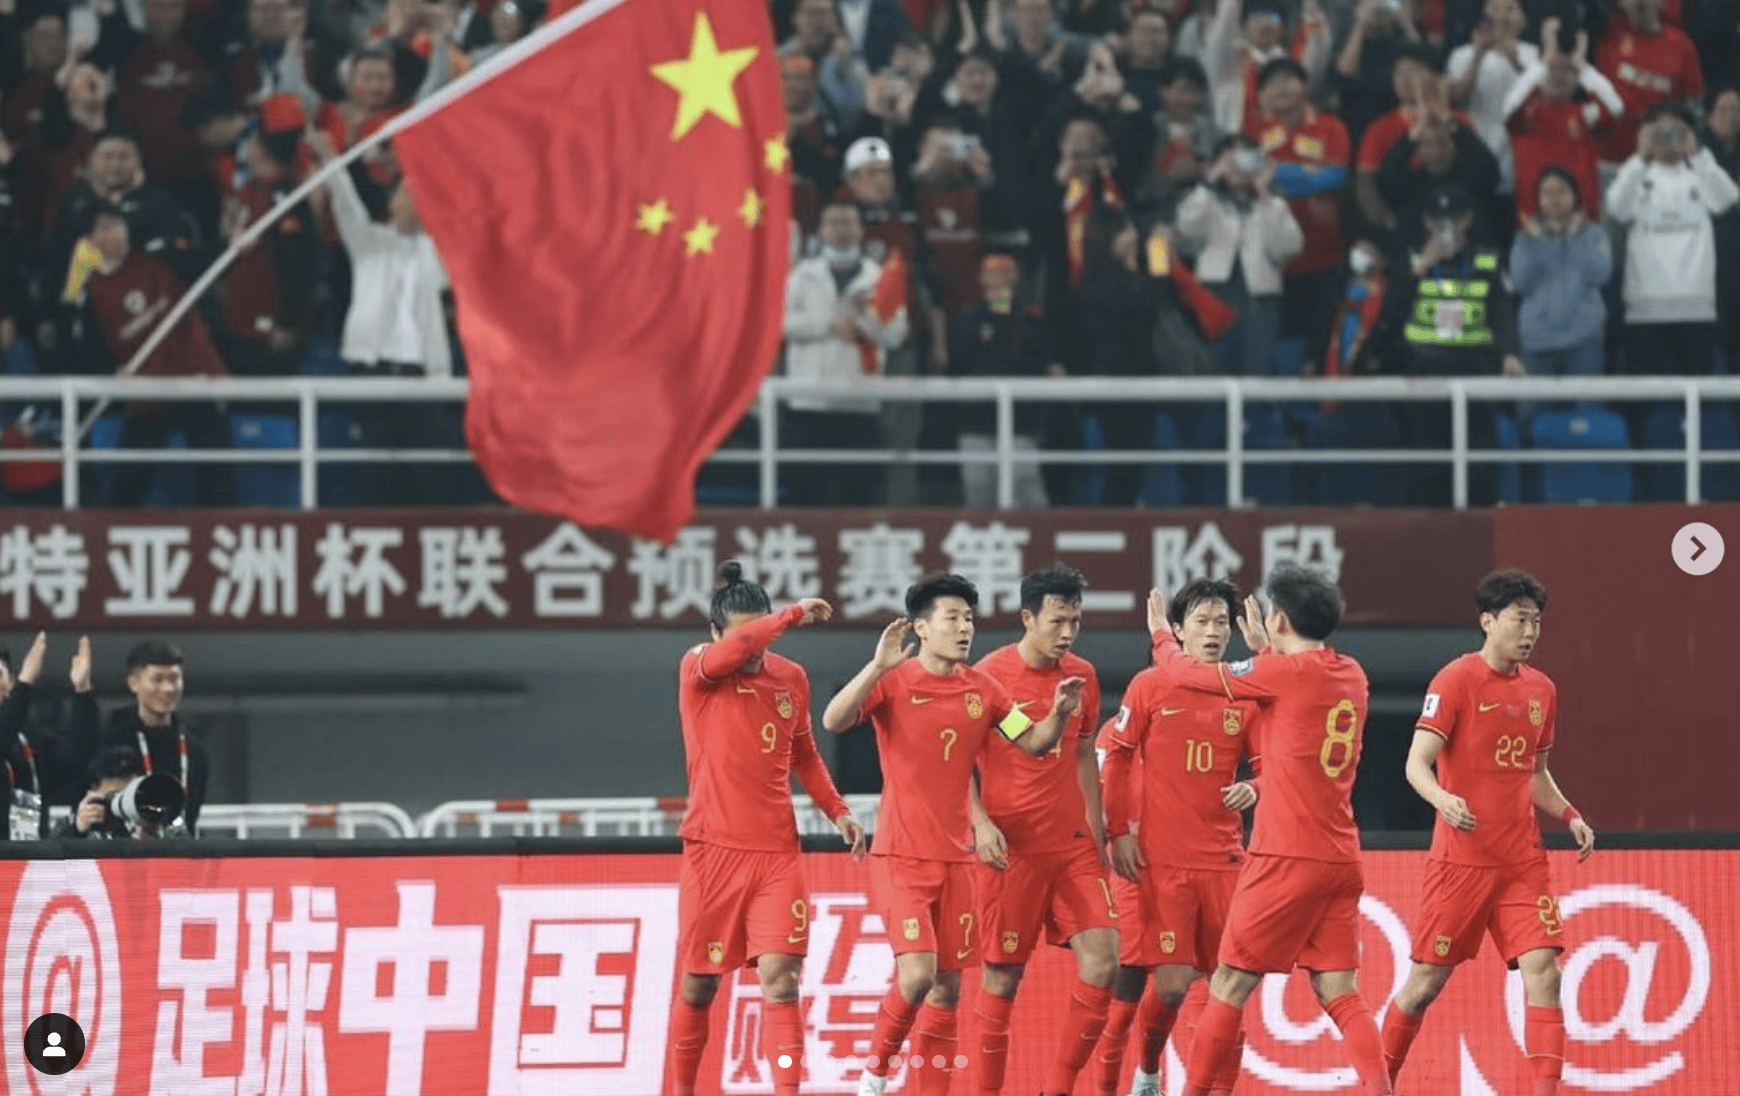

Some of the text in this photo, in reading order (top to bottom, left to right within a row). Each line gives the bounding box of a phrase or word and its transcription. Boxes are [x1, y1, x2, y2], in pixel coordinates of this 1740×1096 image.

[761, 722, 776, 753] 9
[940, 728, 957, 762] 7
[1321, 699, 1357, 777] 8
[1495, 735, 1527, 768] 22
[1185, 739, 1213, 773] 10
[791, 899, 807, 932] 9
[958, 913, 973, 946] 7
[148, 880, 681, 1096] 足球中国
[1505, 884, 1711, 1092] @
